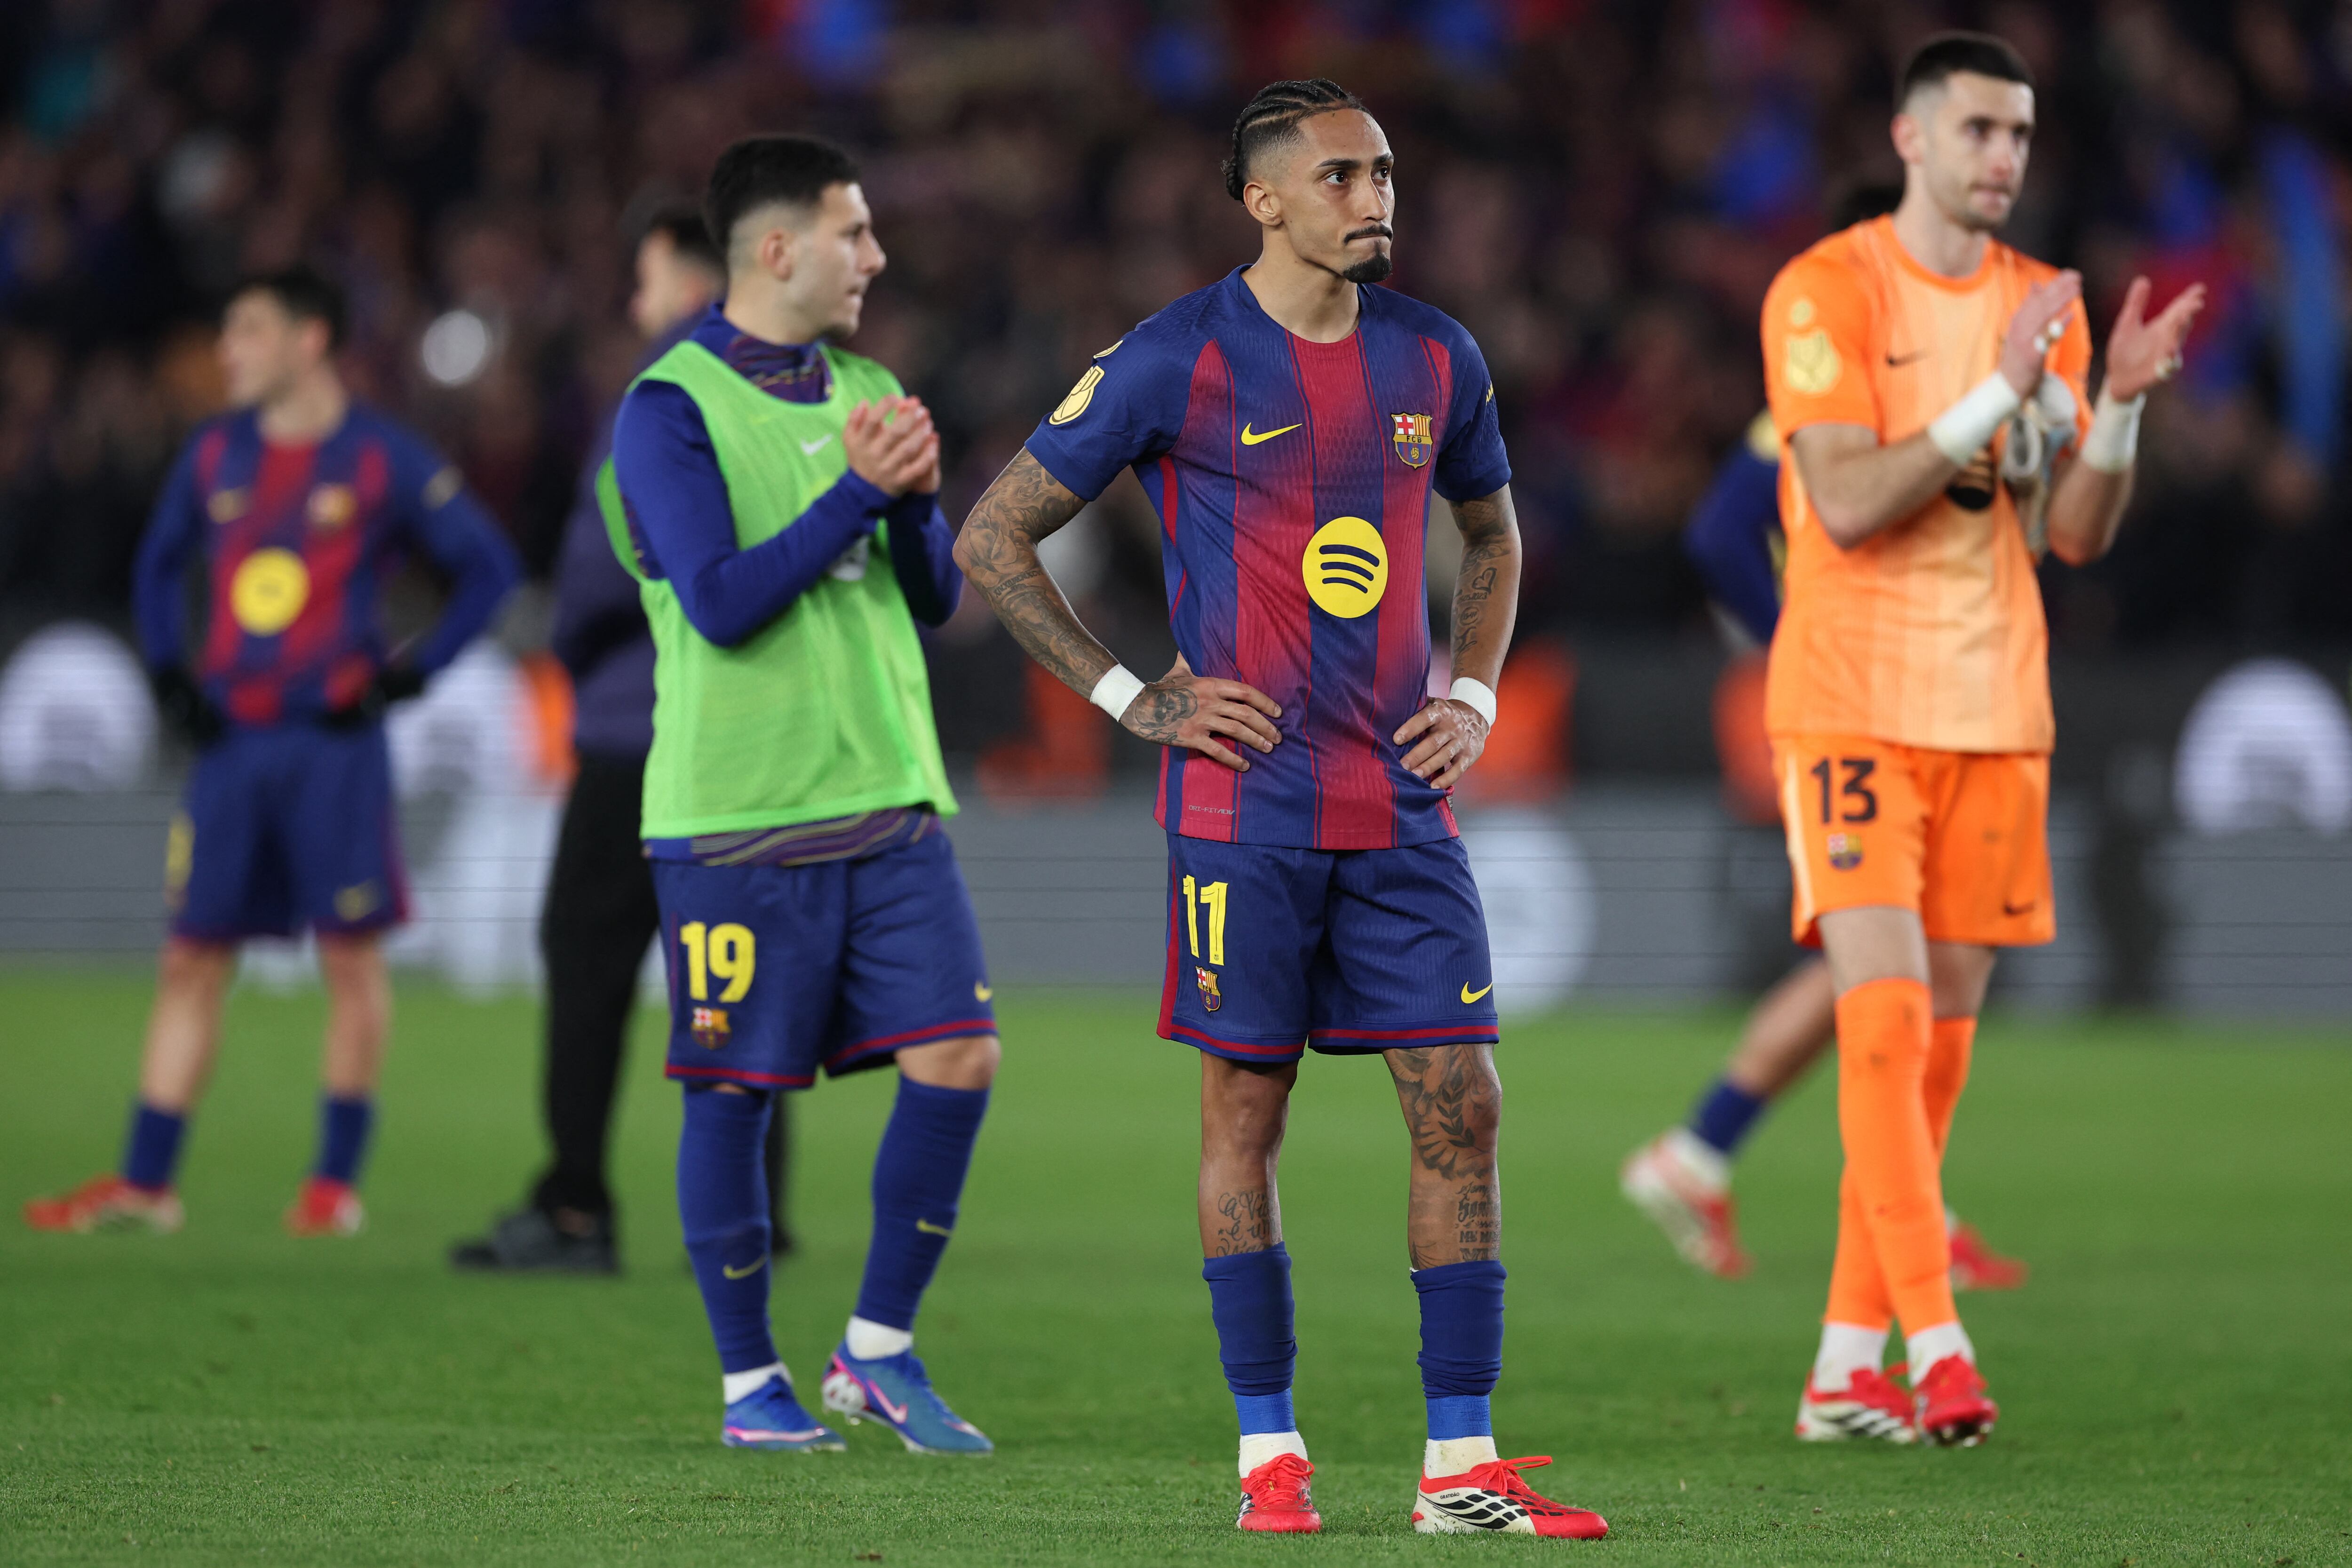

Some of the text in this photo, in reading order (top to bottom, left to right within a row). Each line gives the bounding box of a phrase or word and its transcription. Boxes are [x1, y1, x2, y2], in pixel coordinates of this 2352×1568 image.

[1811, 758, 1877, 824] 13
[680, 920, 756, 1003] 19
[1182, 874, 1229, 966] 11
